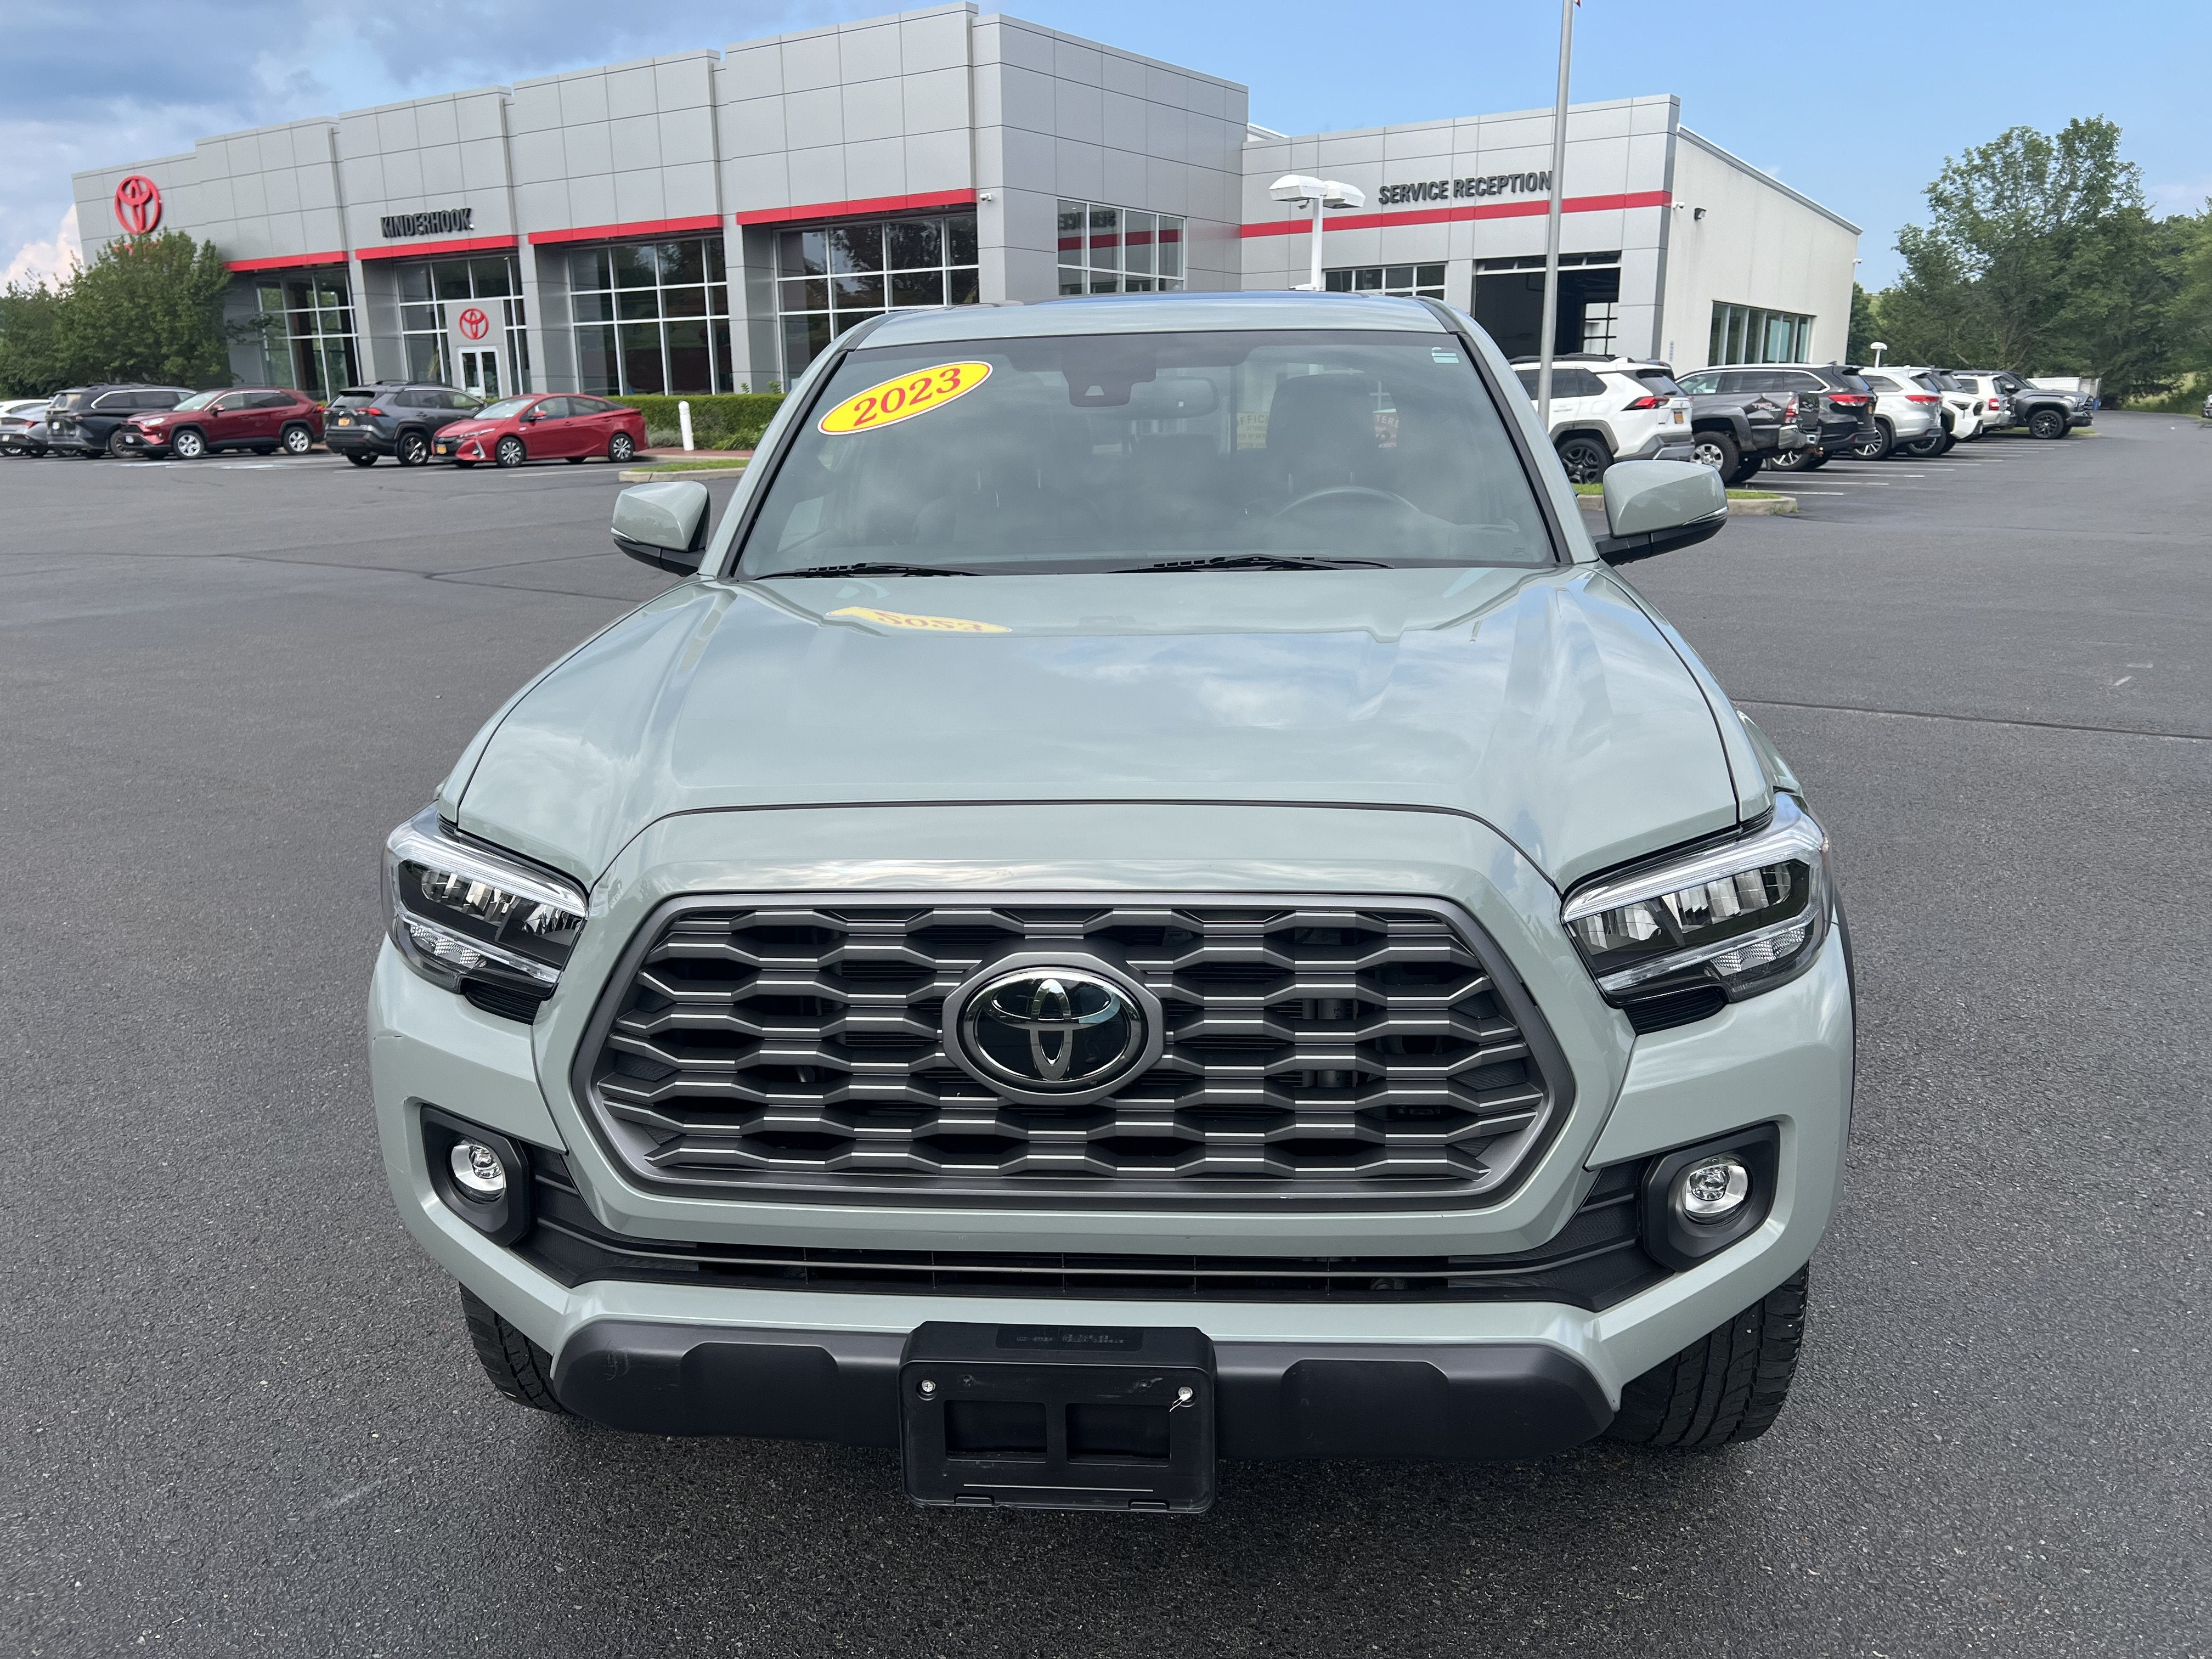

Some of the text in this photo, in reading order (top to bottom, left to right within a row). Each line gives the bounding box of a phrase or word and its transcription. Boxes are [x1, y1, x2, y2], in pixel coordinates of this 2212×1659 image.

[1379, 171, 1552, 204] SERVICE RECEPTION
[380, 208, 473, 238] KINDERHOOK
[854, 368, 961, 426] 2023
